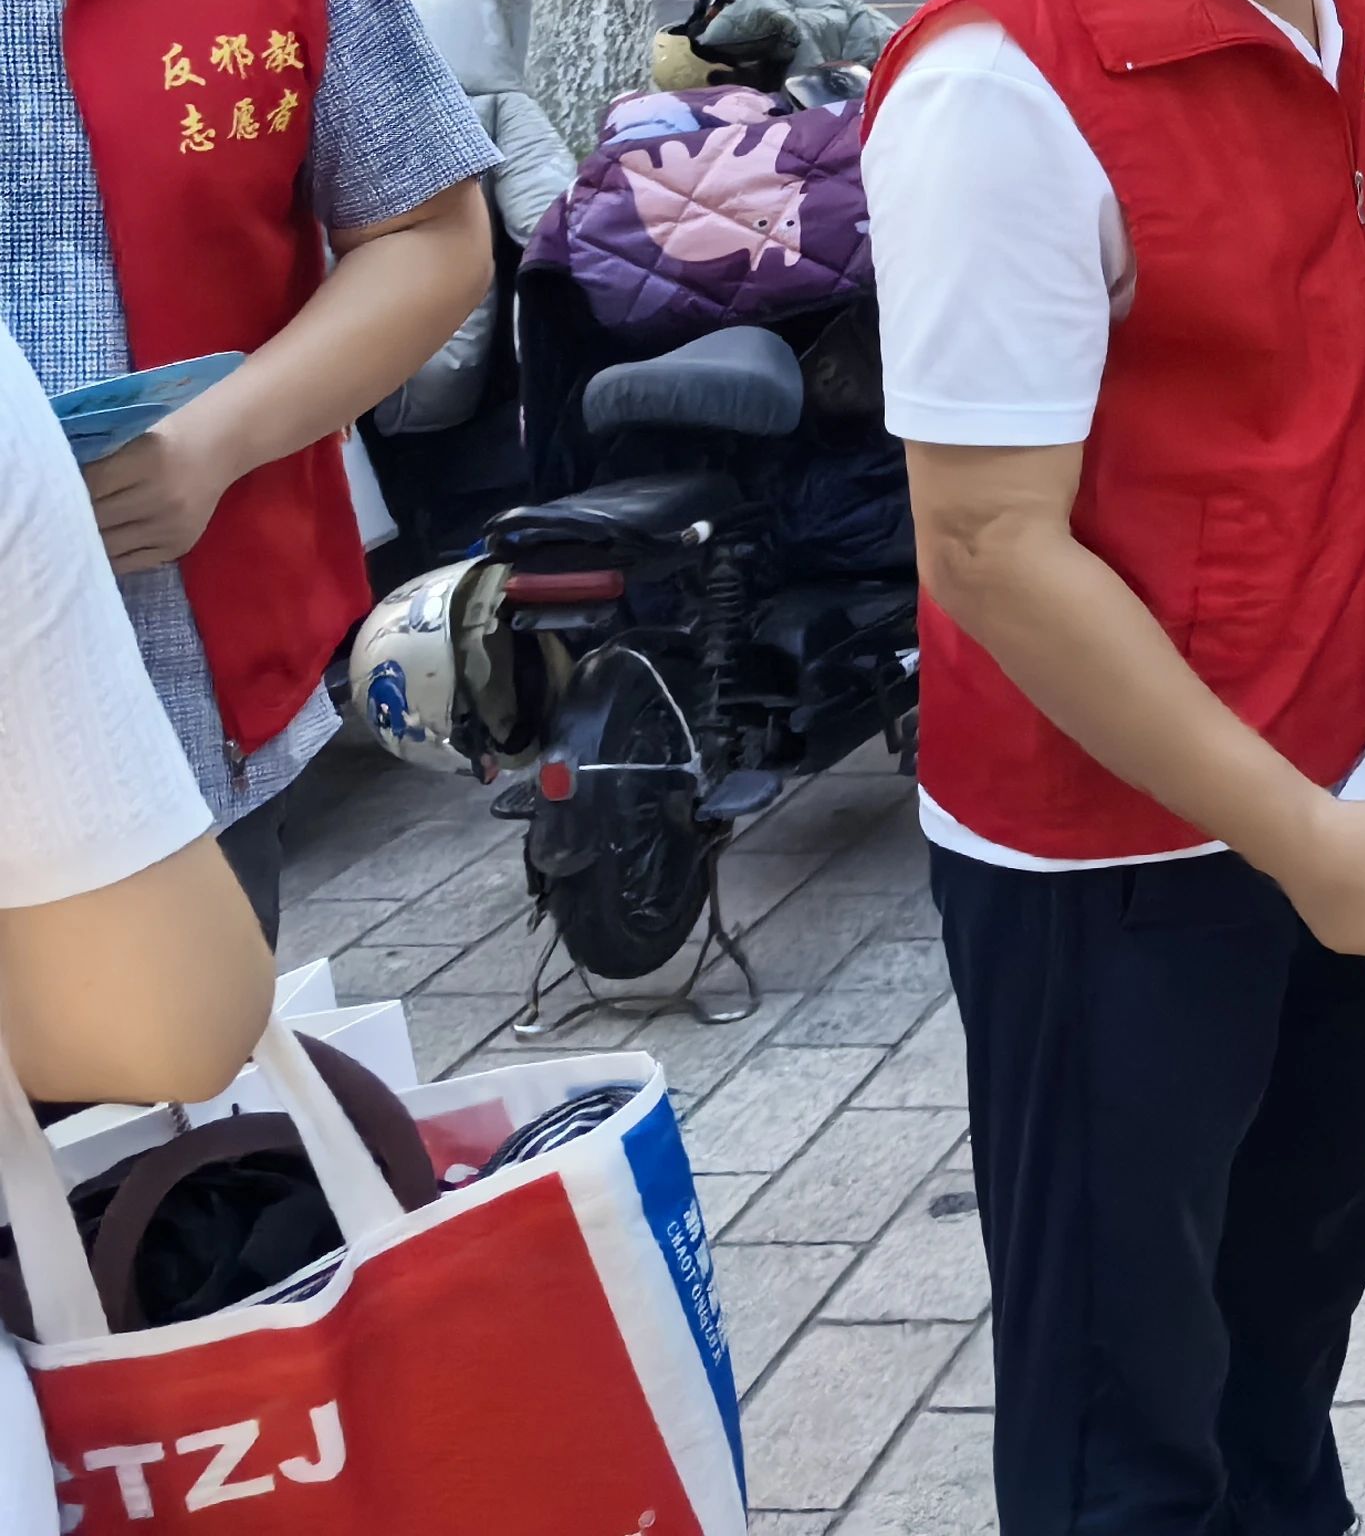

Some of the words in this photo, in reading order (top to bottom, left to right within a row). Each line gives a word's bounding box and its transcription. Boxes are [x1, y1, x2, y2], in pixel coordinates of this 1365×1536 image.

[162, 30, 304, 90] 反邪教
[180, 89, 298, 154] 志愿者
[51, 1399, 346, 1534] TZJ
